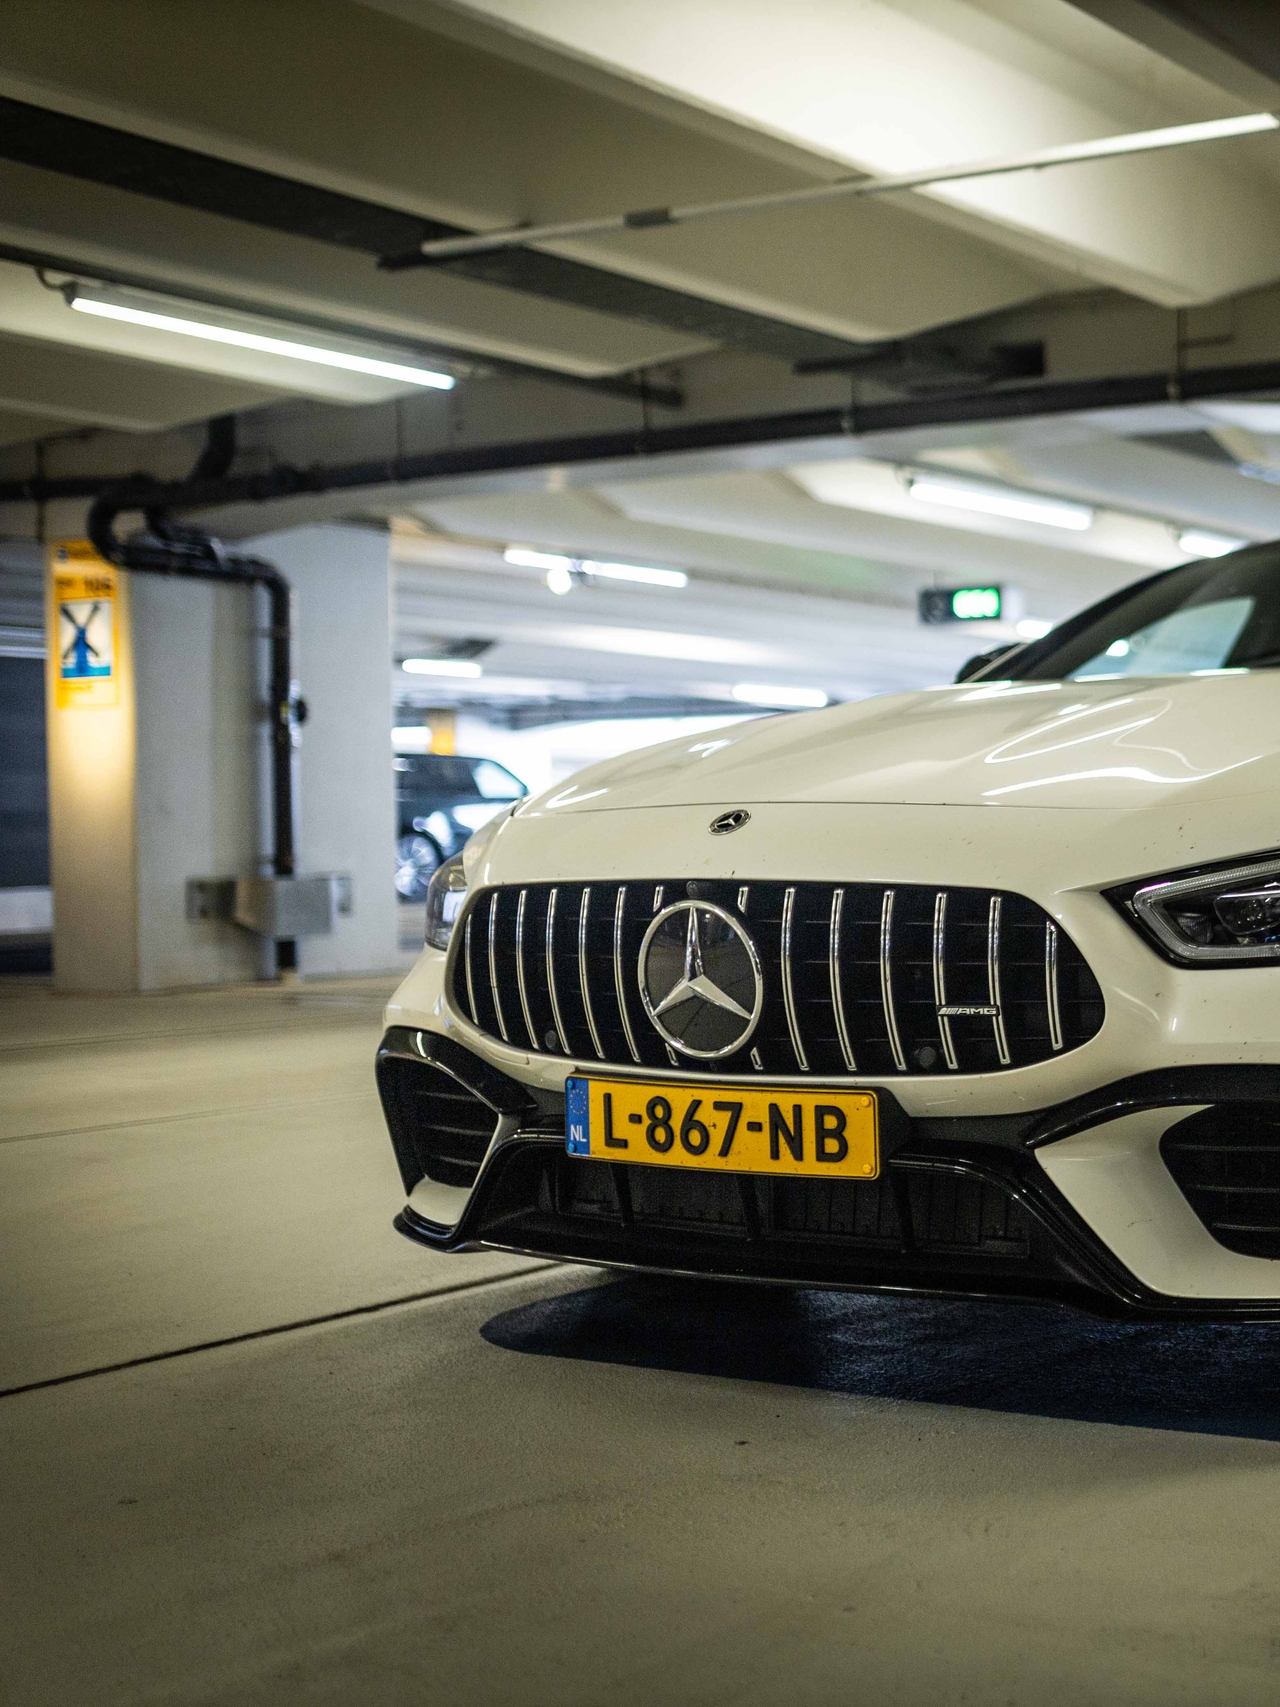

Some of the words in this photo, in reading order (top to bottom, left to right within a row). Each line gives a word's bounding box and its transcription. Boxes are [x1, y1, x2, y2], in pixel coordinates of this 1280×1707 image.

[957, 1007, 997, 1015] AMG
[569, 1124, 587, 1142] NL
[603, 1092, 847, 1163] L-867-NB
